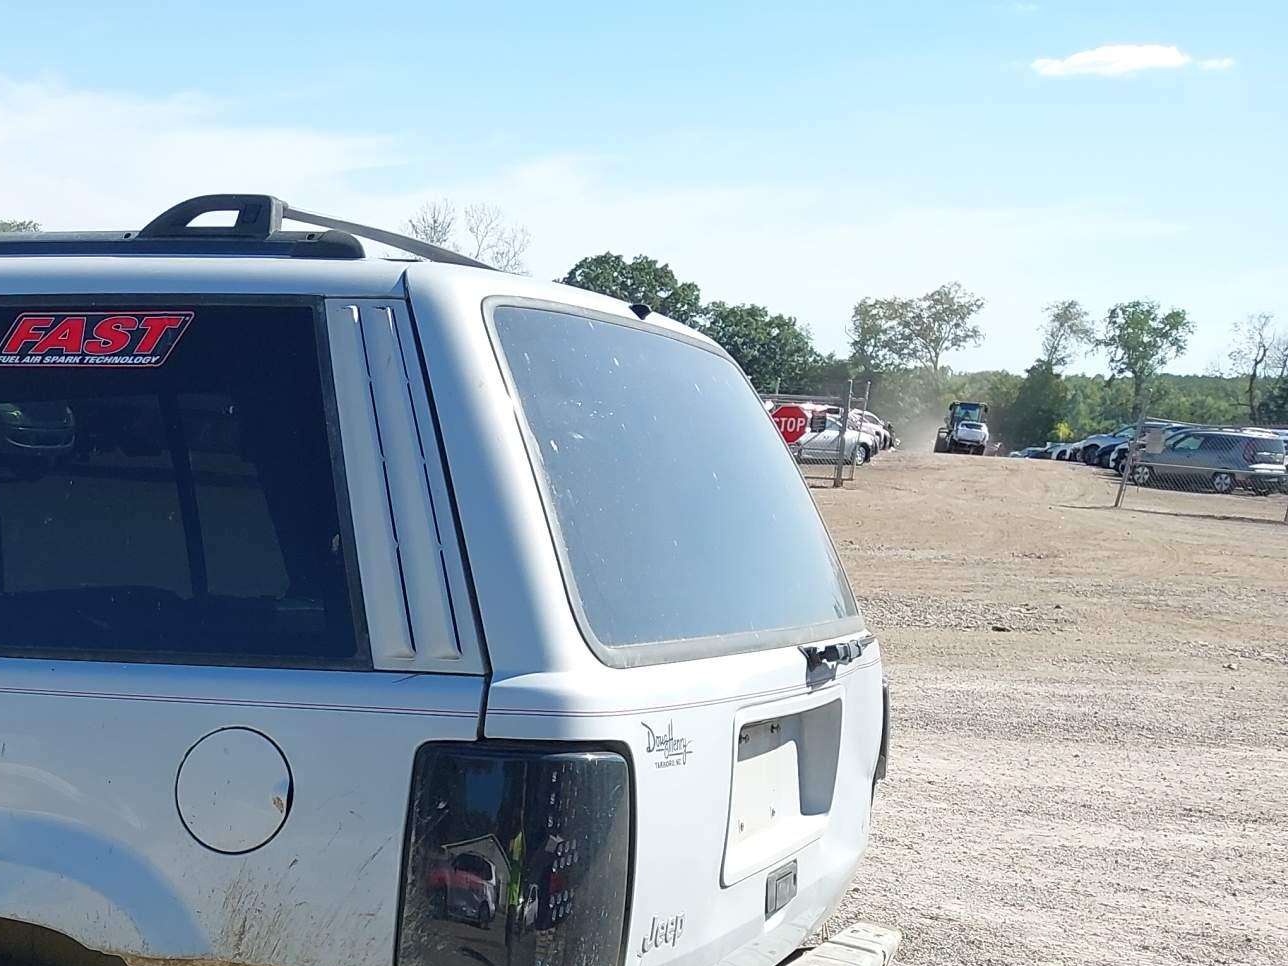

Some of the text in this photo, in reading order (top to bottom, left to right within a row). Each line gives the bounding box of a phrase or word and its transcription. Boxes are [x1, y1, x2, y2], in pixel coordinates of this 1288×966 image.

[2, 316, 185, 355] FAST
[21, 355, 42, 364] AIR
[42, 355, 81, 364] SPARK
[82, 355, 160, 365] TECHNOLOGY
[640, 911, 686, 955] Jeep
